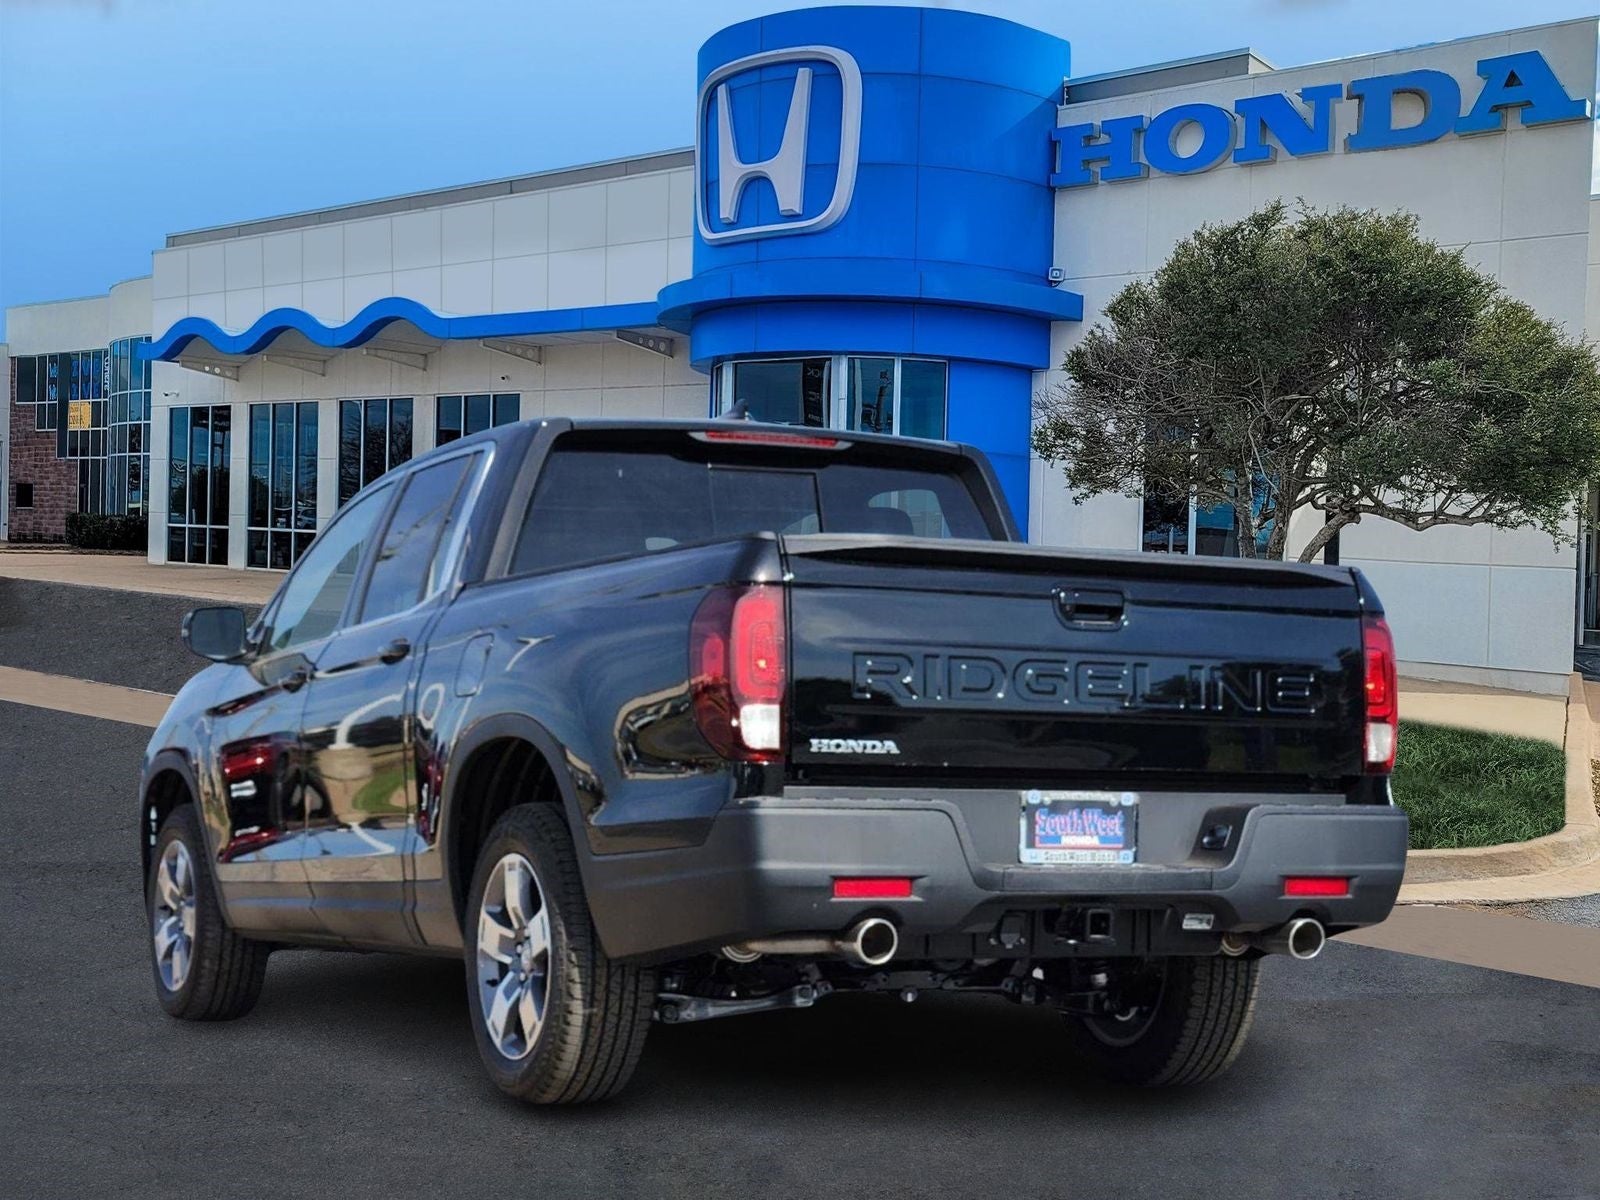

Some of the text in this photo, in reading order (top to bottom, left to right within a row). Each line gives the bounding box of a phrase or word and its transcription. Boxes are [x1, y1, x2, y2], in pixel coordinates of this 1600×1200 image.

[1050, 50, 1592, 188] HONDA
[852, 652, 1322, 714] RIDGELINE
[809, 738, 901, 754] HONDA
